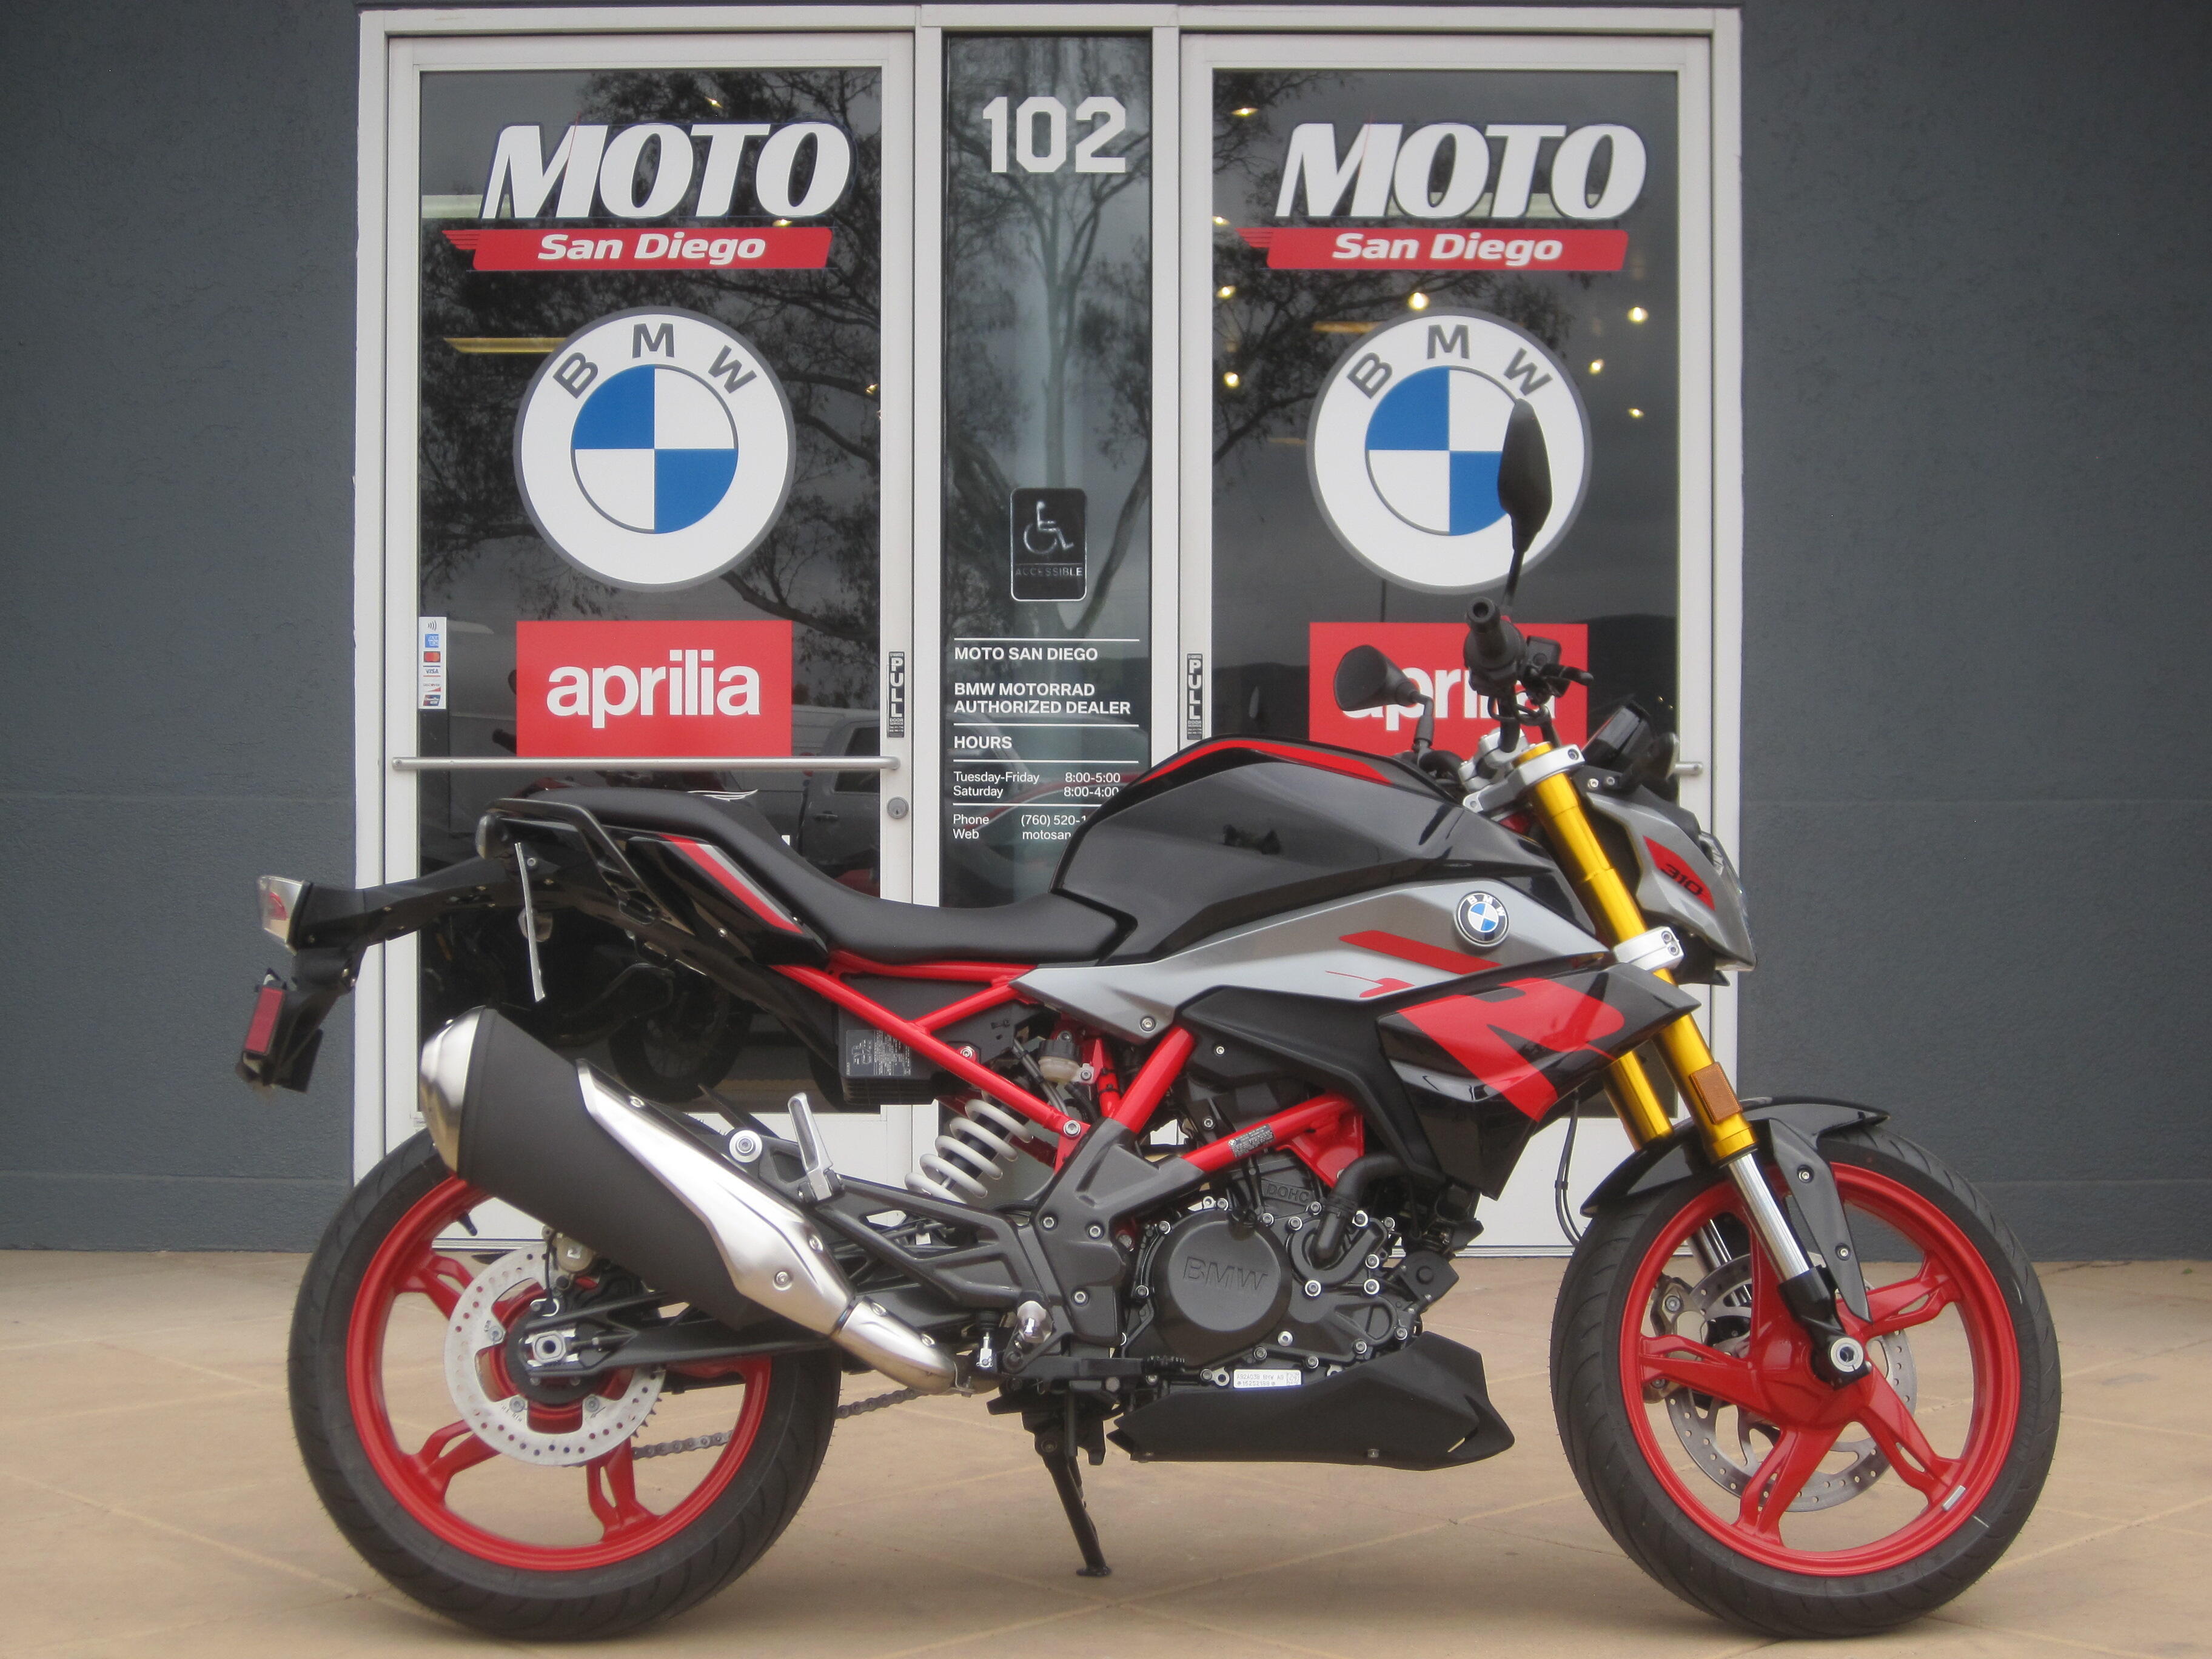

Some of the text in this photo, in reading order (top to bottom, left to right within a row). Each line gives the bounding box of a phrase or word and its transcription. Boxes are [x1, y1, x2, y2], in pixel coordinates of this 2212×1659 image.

[982, 96, 1126, 173] 102
[481, 122, 851, 219] MOTO
[1275, 122, 1647, 220] MOTO
[537, 232, 766, 266] San Diego
[1332, 232, 1563, 267] San Diego
[552, 323, 757, 399] BMW
[1346, 324, 1552, 400] BMW
[1015, 567, 1083, 576] ACCESSIBLE
[954, 647, 1098, 661] MOTO SAN DIEGO
[546, 649, 760, 729] aprilia
[890, 657, 903, 717] PULL
[954, 683, 1095, 696] BMW MOTORRAD
[1188, 659, 1202, 720] PULL
[954, 700, 1131, 714] AUTHORIZED DEALER
[954, 736, 1012, 749] HOURS
[953, 771, 1121, 785] Tuesday-Friday 8:00-5:00
[953, 785, 1004, 799] Saturday
[953, 814, 990, 825] Phone
[1021, 814, 1050, 827] (760)
[953, 828, 979, 839] Web
[1660, 863, 1703, 896] 310
[1467, 894, 1506, 916] BMW
[1266, 1184, 1310, 1202] DOHC
[1183, 1256, 1268, 1290] BMW
